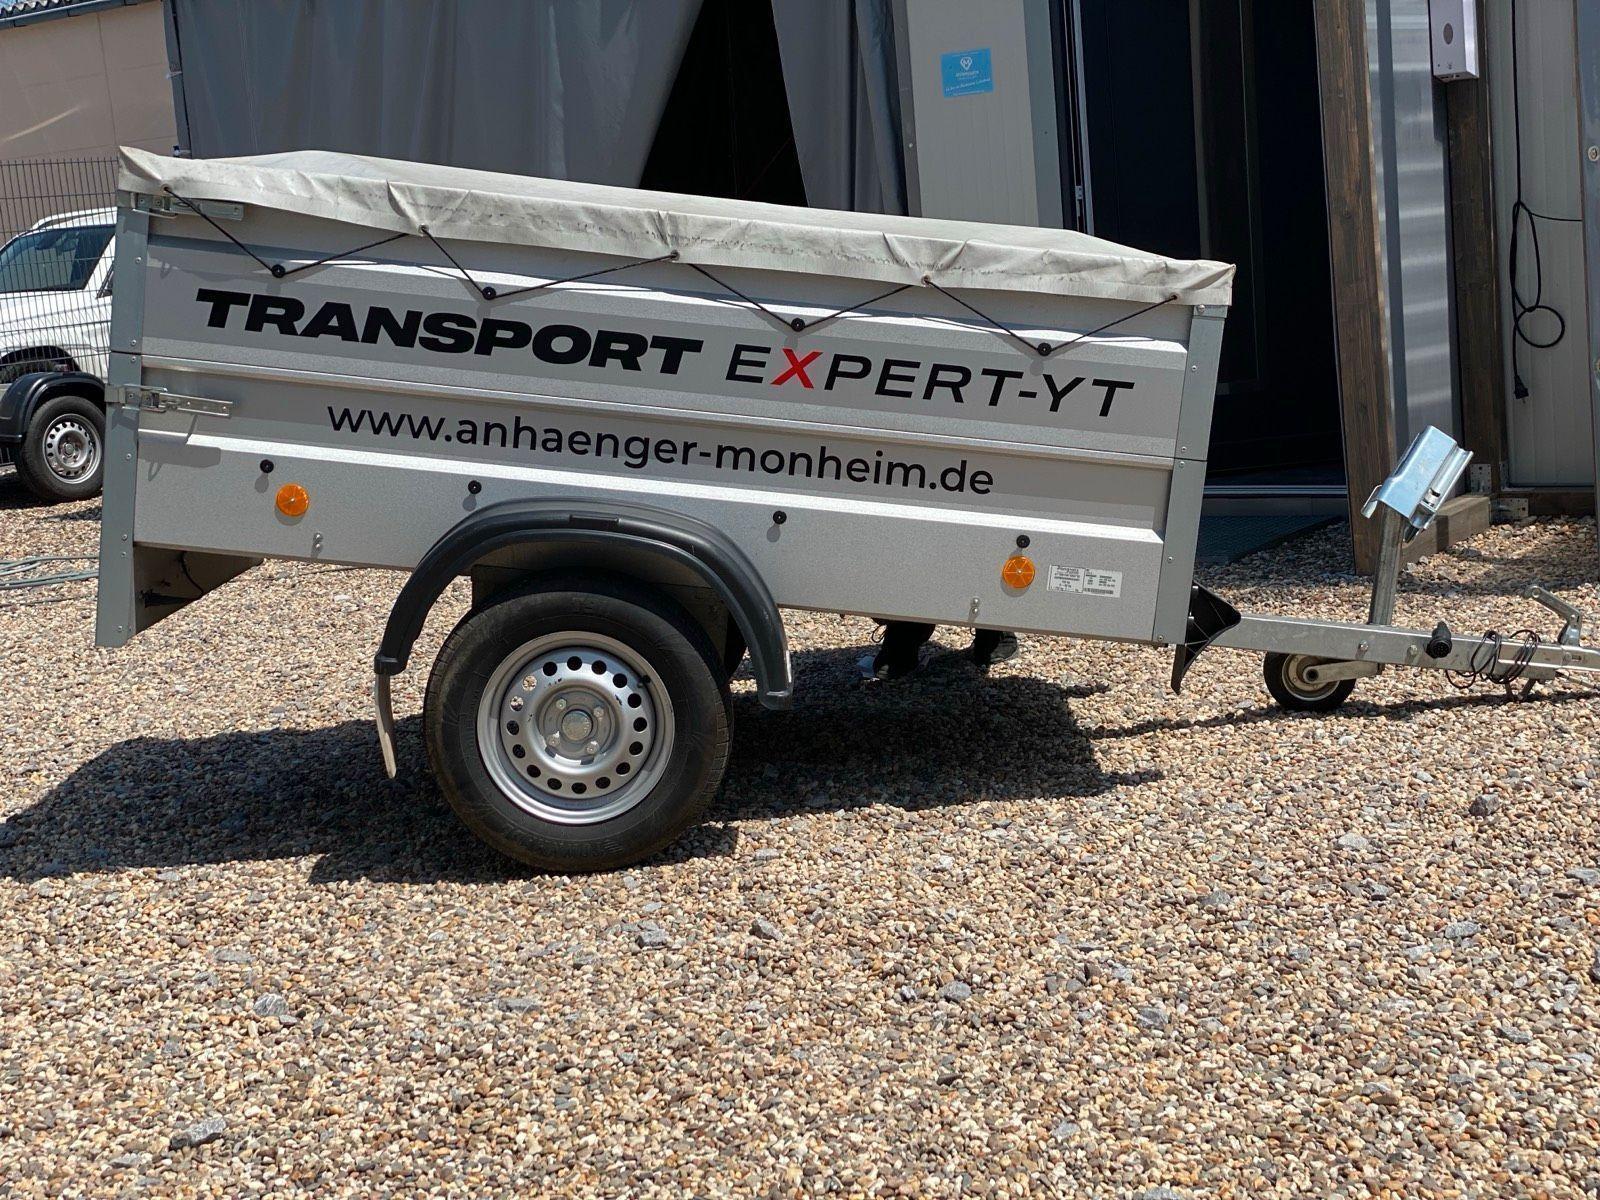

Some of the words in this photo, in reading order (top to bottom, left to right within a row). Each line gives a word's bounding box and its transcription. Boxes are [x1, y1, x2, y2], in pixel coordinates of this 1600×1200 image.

[196, 288, 704, 375] TRANSPORT
[725, 343, 1135, 417] EXPERT-YT
[327, 405, 994, 495] www.anhaenger-monheim.de
